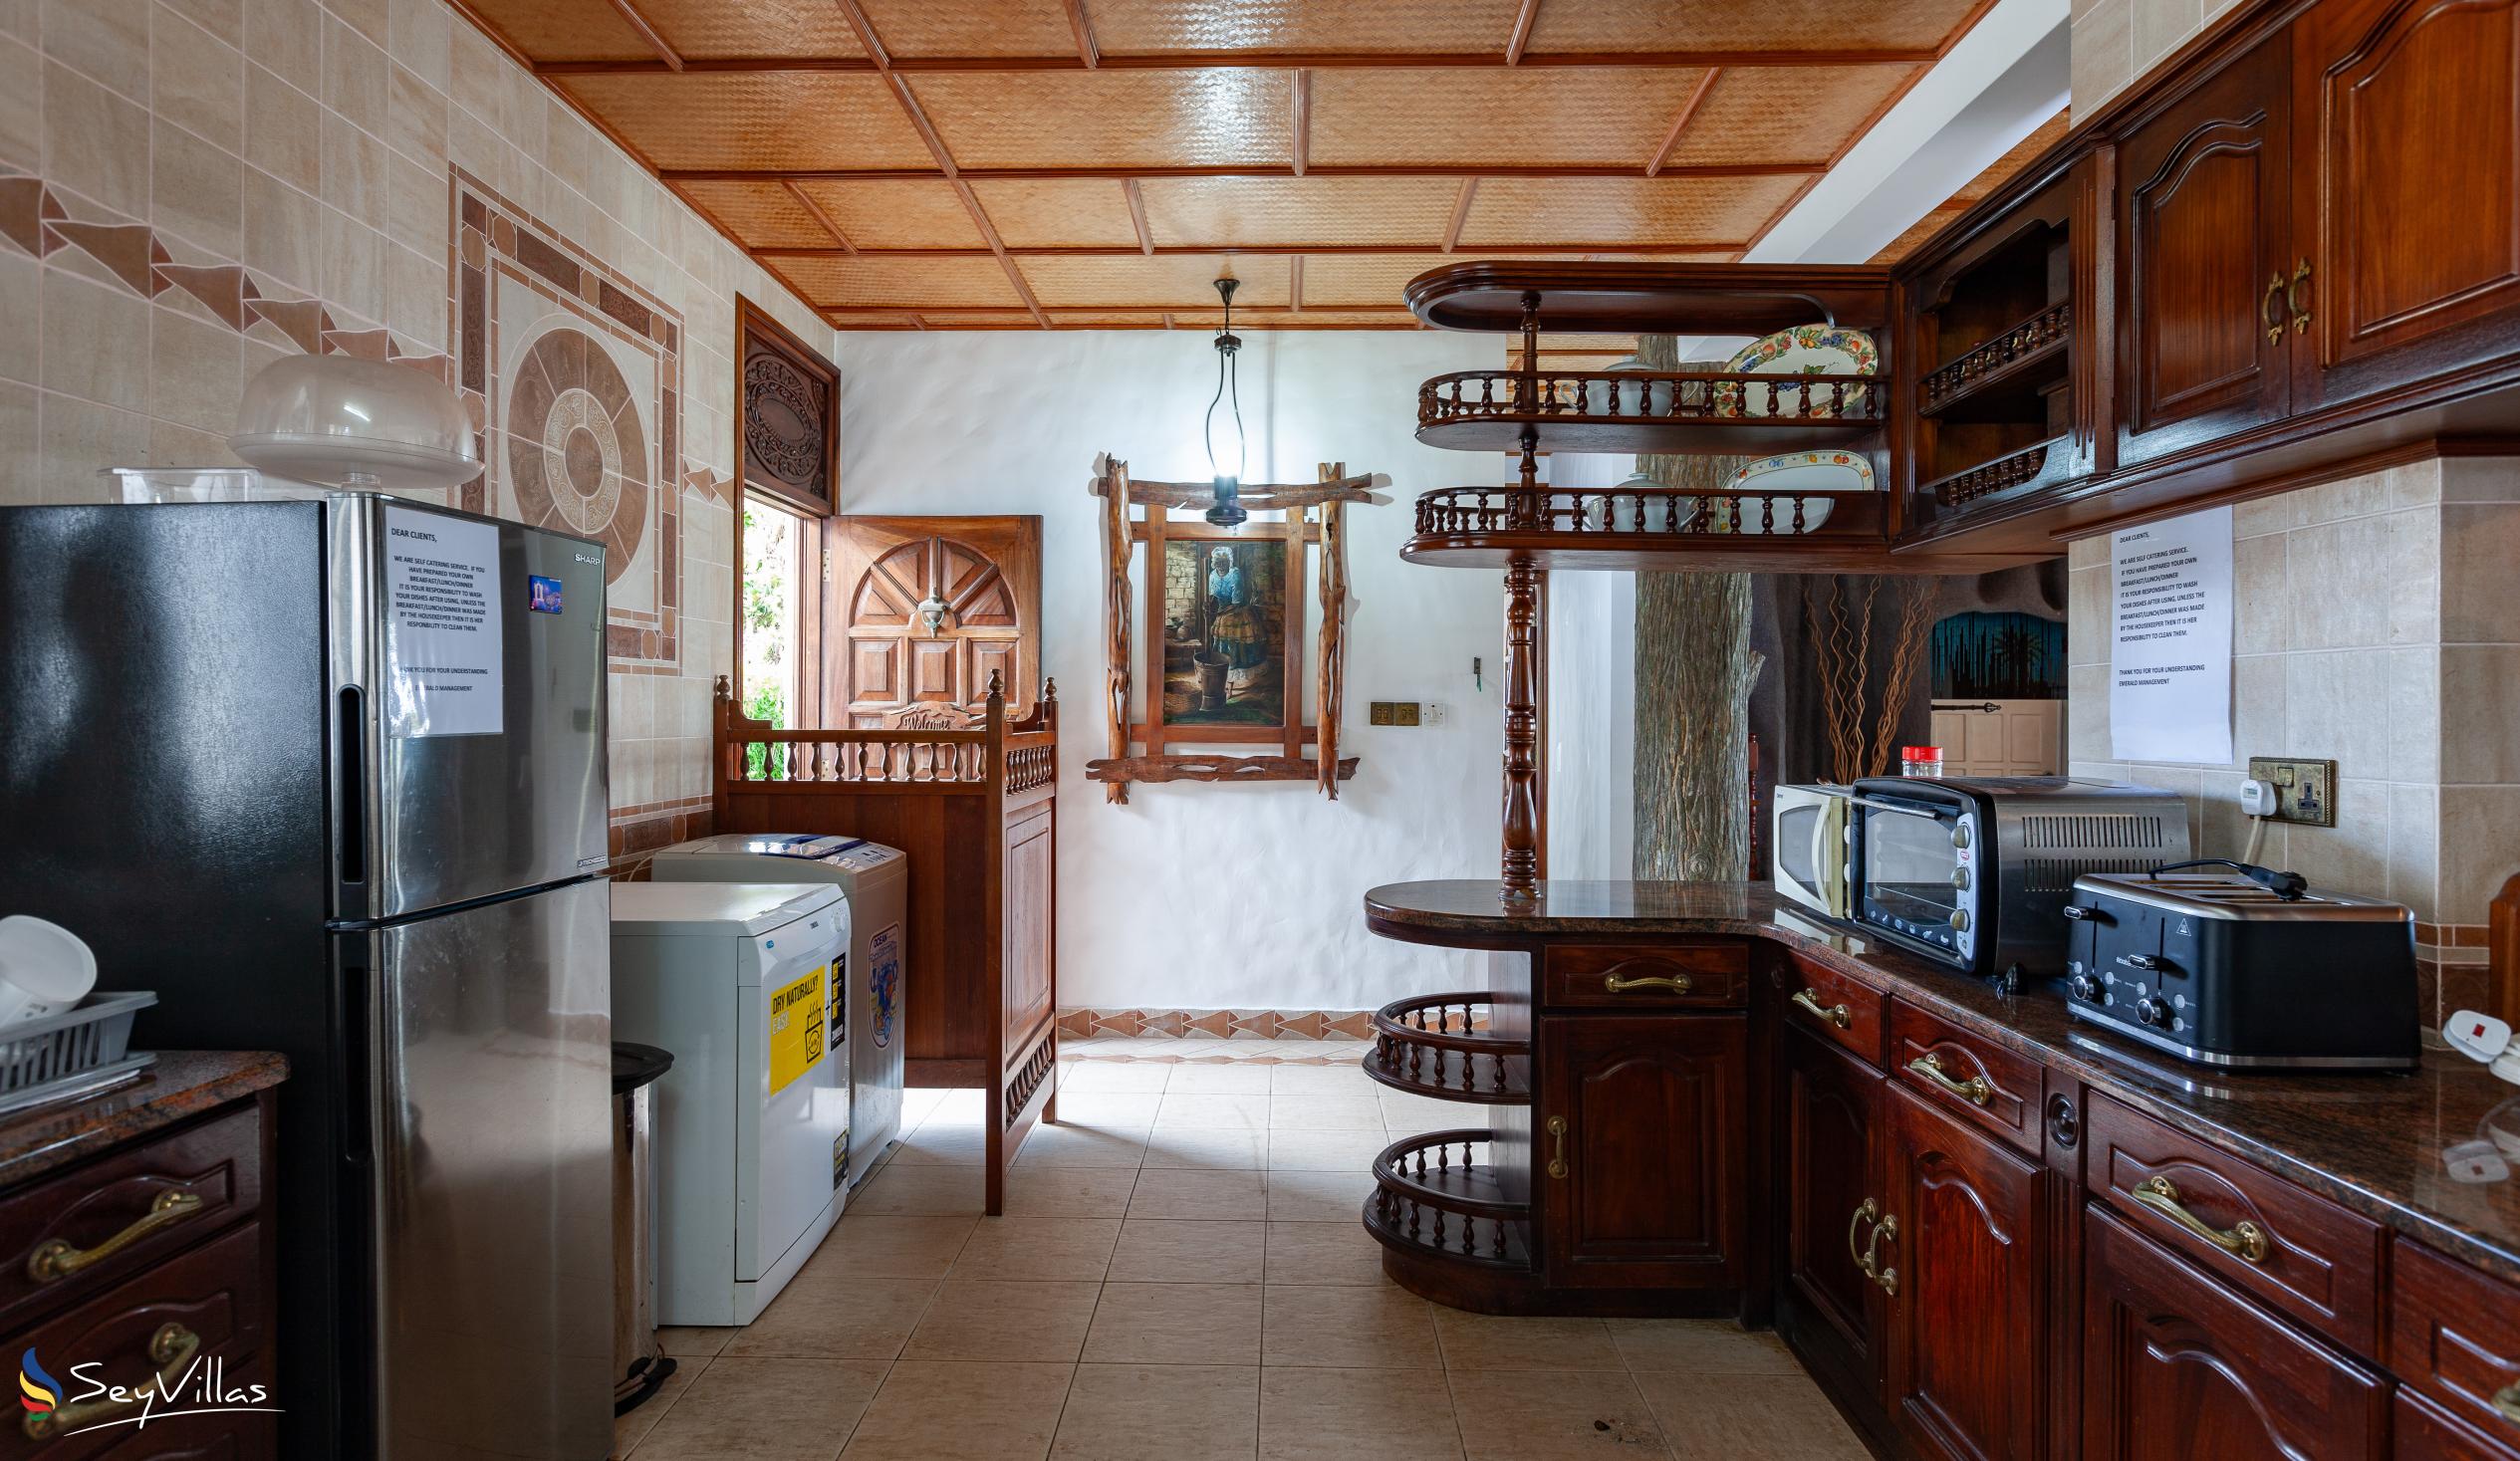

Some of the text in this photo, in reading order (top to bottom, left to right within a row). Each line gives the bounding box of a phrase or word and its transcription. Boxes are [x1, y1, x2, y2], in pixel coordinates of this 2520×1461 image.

[391, 528, 437, 542] DEAR CLIENTS,
[2132, 532, 2150, 540] CLIENTS,
[575, 553, 600, 565] SHARP
[2146, 551, 2168, 560] CATERING
[426, 560, 449, 568] CATERING
[2148, 561, 2170, 571] PREPARED
[423, 568, 447, 576] PREPARED
[409, 576, 473, 588] BREAKFAST/LUNCH/DINNER
[2121, 572, 2179, 587] BREAKFAST/LUNCH/DINNER
[426, 587, 461, 595] RESPONSIBILITY
[2142, 584, 2174, 595] RESPONSIBILITY
[396, 602, 461, 613] BREAKFAST/LUNCH/DINNER
[2120, 608, 2177, 620] BREAKFAST/LUNCH/DINNER
[2135, 620, 2164, 630] HOUSEKEEPER
[2120, 634, 2151, 642] RESPONSIBILITY
[2165, 664, 2205, 673] UNDERSTANDING
[904, 713, 951, 730] Welcome
[773, 993, 785, 1015] DRY
[786, 975, 818, 1007] NATURALLY?
